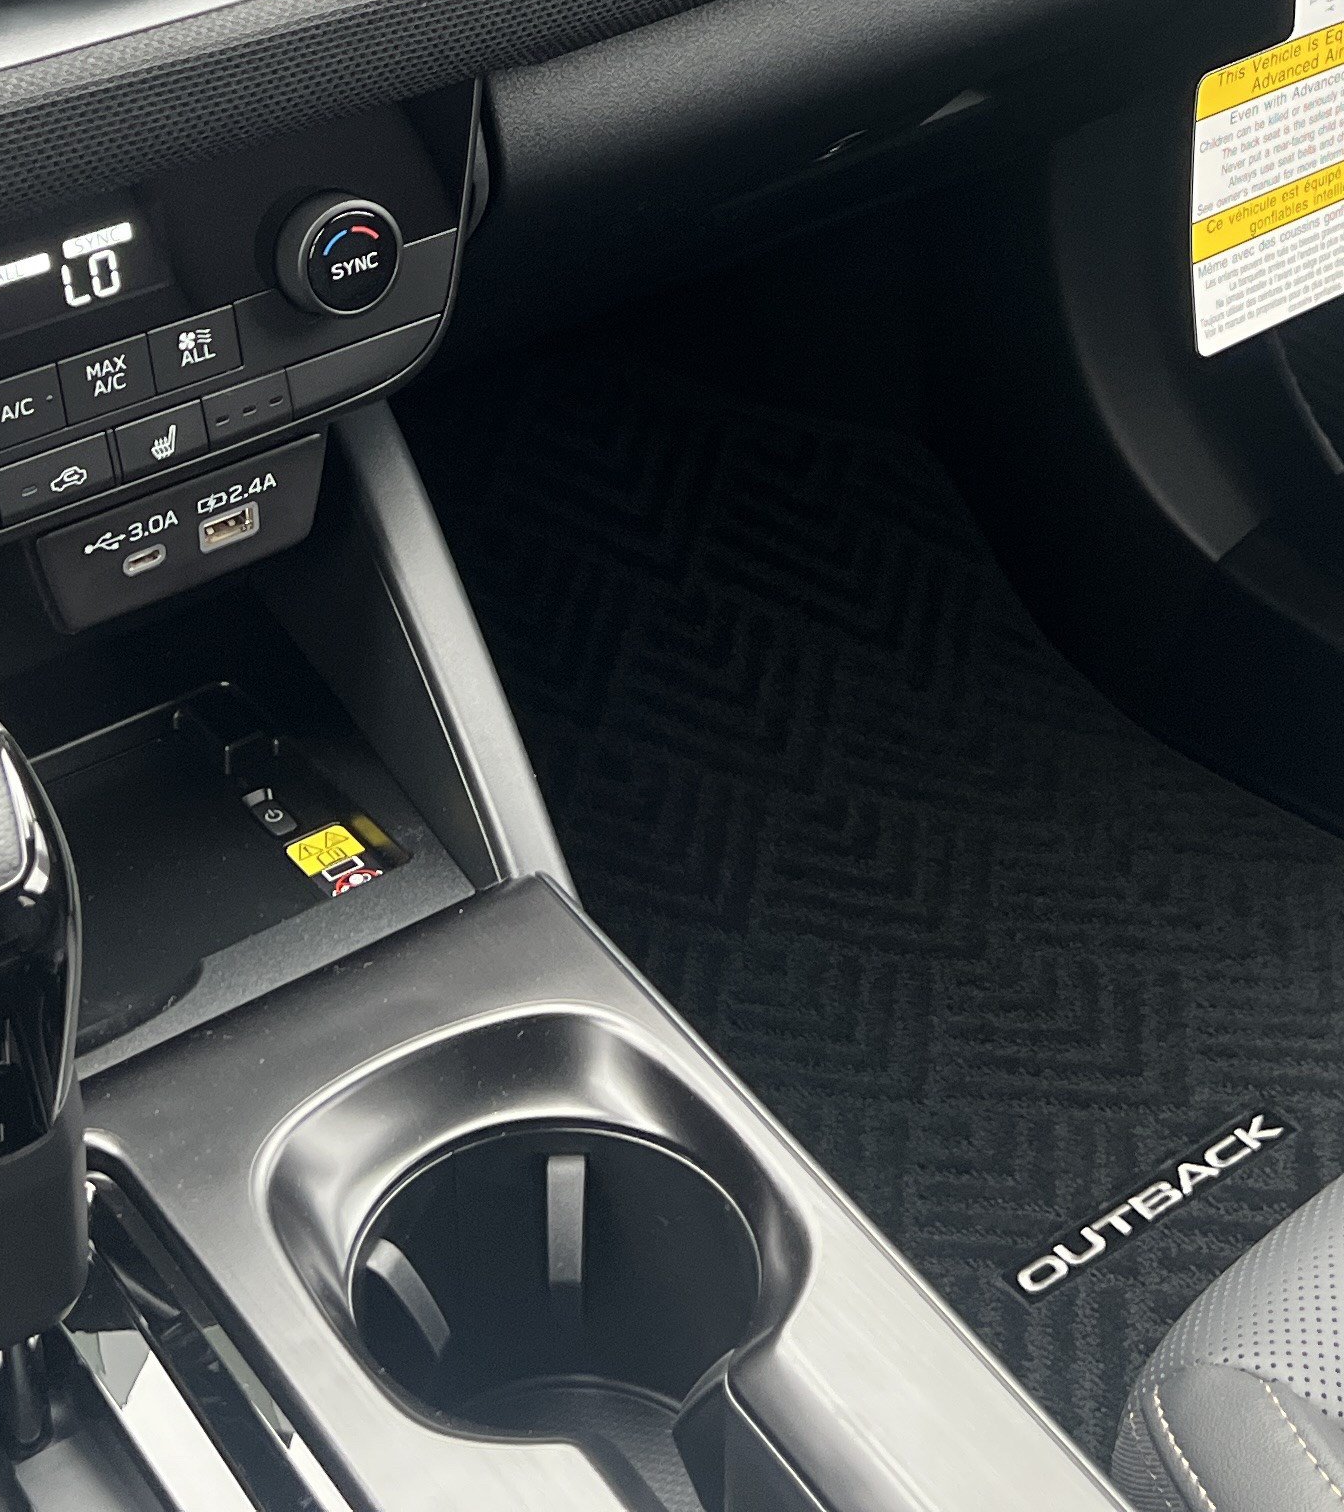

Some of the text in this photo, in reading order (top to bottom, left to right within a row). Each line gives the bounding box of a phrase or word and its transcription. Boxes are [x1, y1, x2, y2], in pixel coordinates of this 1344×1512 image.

[1217, 67, 1246, 87] This
[1252, 44, 1301, 73] Vehicle
[1252, 53, 1319, 93] Advanced
[1325, 46, 1344, 65] Air
[1230, 105, 1259, 125] Even
[1264, 92, 1287, 111] with
[1206, 219, 1224, 234] Ce
[1228, 195, 1277, 225] véhicule
[1281, 185, 1299, 203] est
[1304, 165, 1342, 195] équipé
[1250, 198, 1309, 239] gonflables
[74, 226, 121, 254] SYNC
[1231, 245, 1256, 265] avec
[1279, 214, 1321, 243] coussins
[61, 249, 122, 308] LO
[330, 251, 379, 281] SYNC
[85, 354, 128, 382] MAX
[180, 343, 217, 368] ALL
[94, 373, 128, 397] A/C
[0, 397, 35, 423] A/C
[228, 472, 278, 505] 2.4A
[127, 509, 180, 543] 3.0A
[1016, 1114, 1284, 1292] OUTBACK
